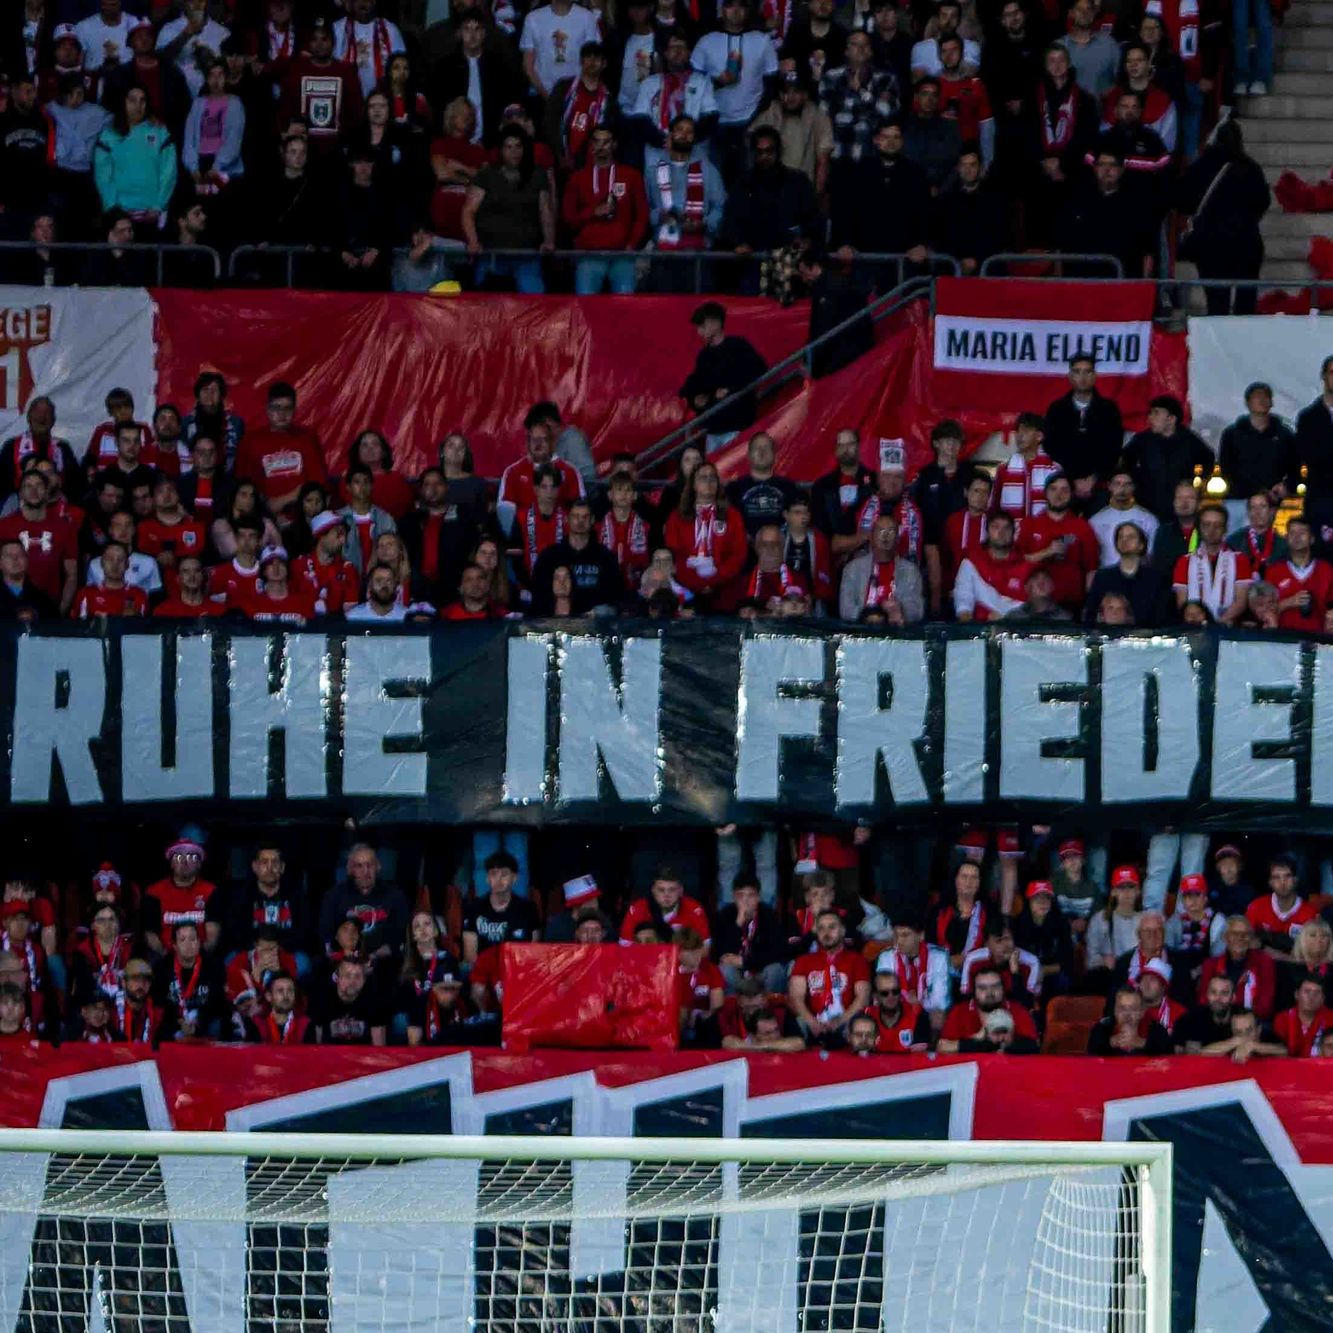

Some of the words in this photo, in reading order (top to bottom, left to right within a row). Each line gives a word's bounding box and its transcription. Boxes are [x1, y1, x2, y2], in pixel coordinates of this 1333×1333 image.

[946, 328, 1037, 361] MARIA
[10, 633, 431, 806] RUHE
[503, 630, 664, 804] IN
